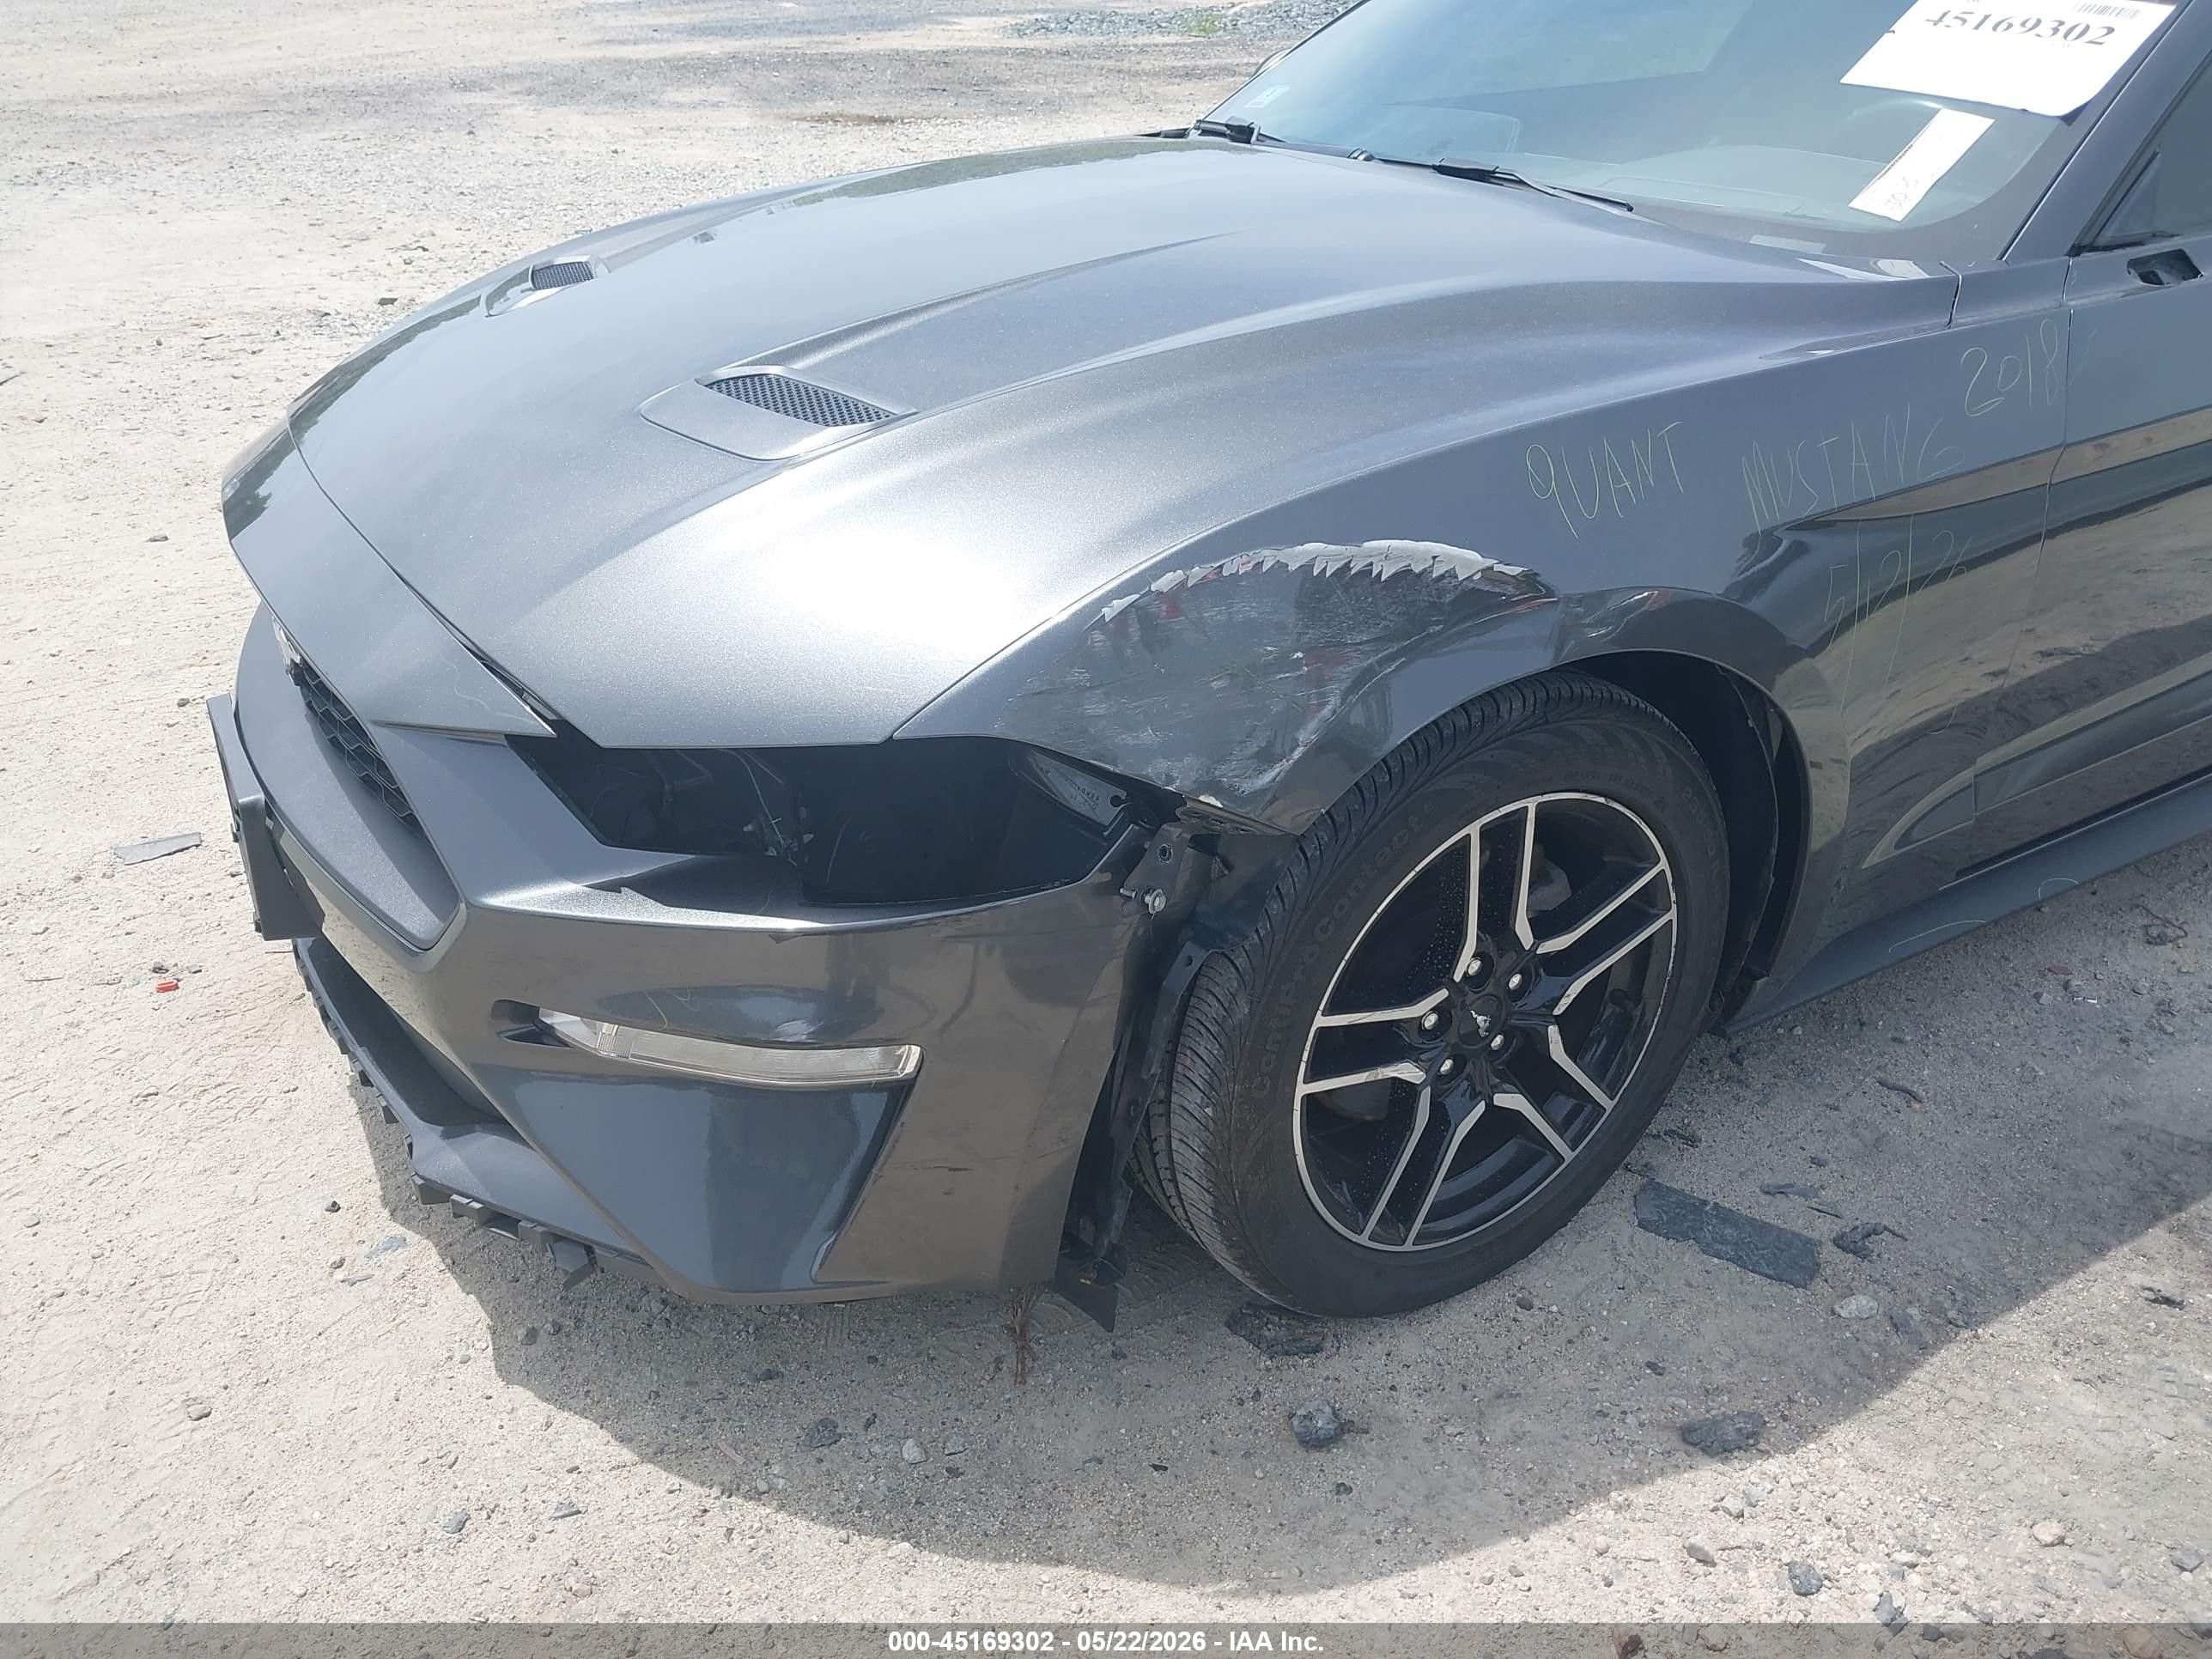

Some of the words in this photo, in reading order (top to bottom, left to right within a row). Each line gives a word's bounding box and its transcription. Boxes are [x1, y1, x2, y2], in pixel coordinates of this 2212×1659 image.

[1924, 9, 2116, 46] 45169302
[1741, 401, 1966, 537] MUSTANG
[1960, 319, 2059, 417] 2018
